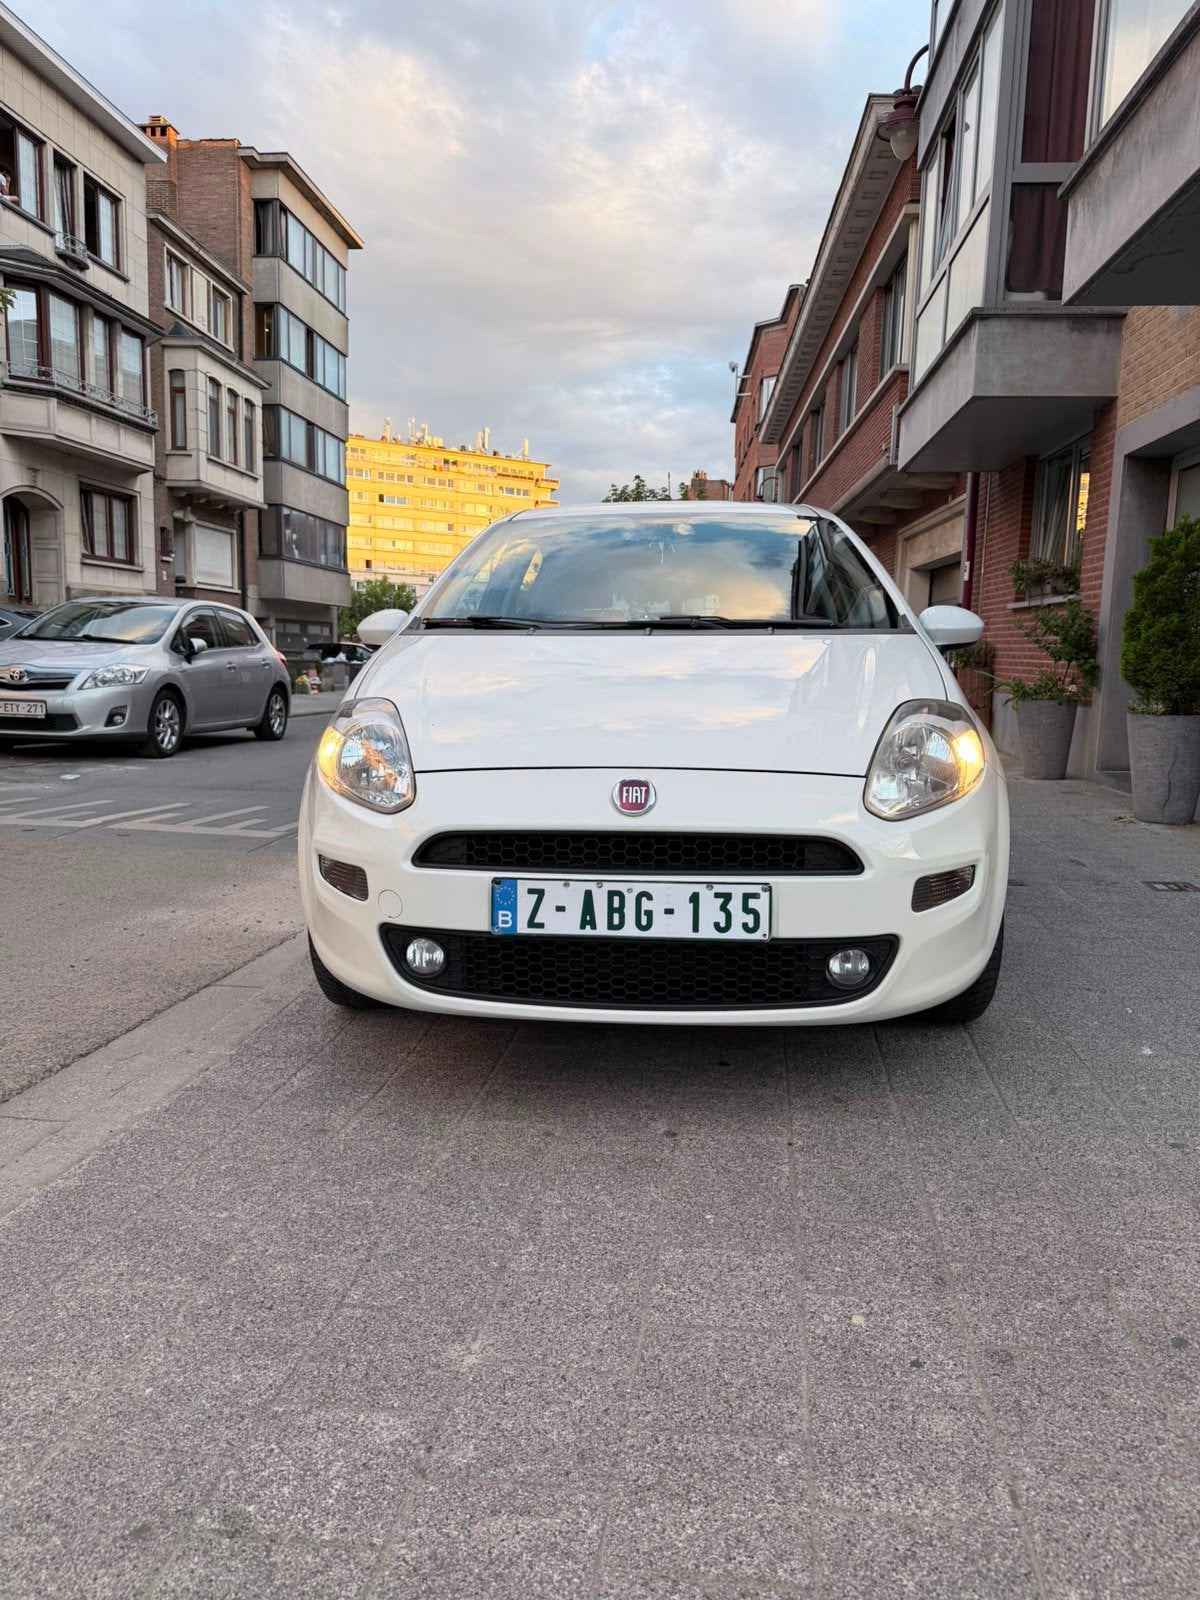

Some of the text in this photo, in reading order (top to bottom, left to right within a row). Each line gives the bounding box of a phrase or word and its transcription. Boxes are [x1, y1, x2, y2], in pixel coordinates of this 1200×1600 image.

[622, 786, 647, 803] FIAT
[498, 910, 513, 928] B
[527, 888, 761, 934] Z-ABG-135
